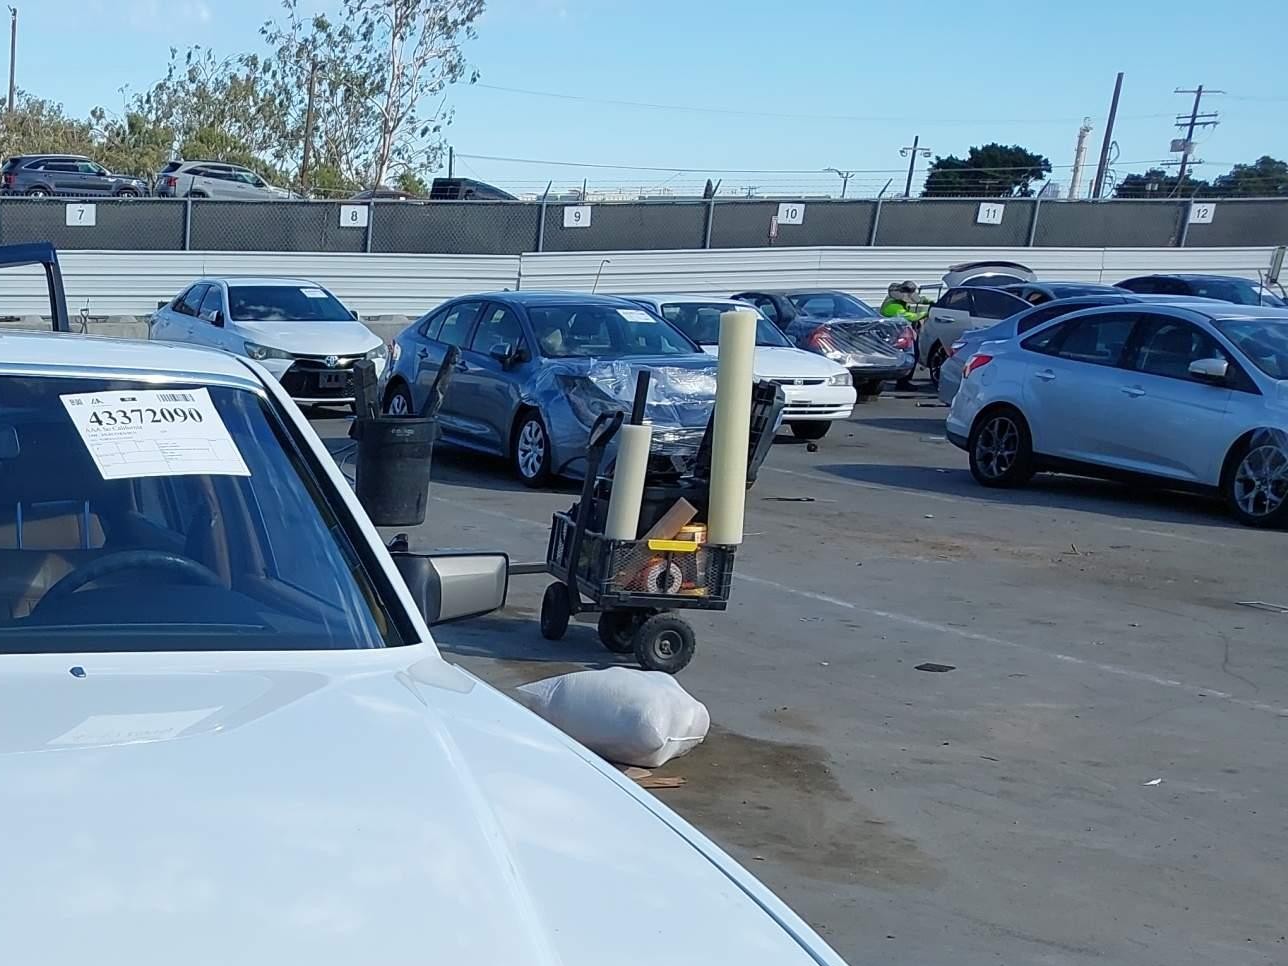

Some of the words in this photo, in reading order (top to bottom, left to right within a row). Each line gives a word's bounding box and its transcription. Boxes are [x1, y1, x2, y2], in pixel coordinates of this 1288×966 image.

[77, 209, 85, 221] 7
[351, 210, 358, 222] 8
[574, 211, 581, 222] 9
[785, 208, 797, 219] 10
[985, 208, 997, 219] 11
[1196, 208, 1208, 219] 12
[89, 407, 203, 426] 43372090
